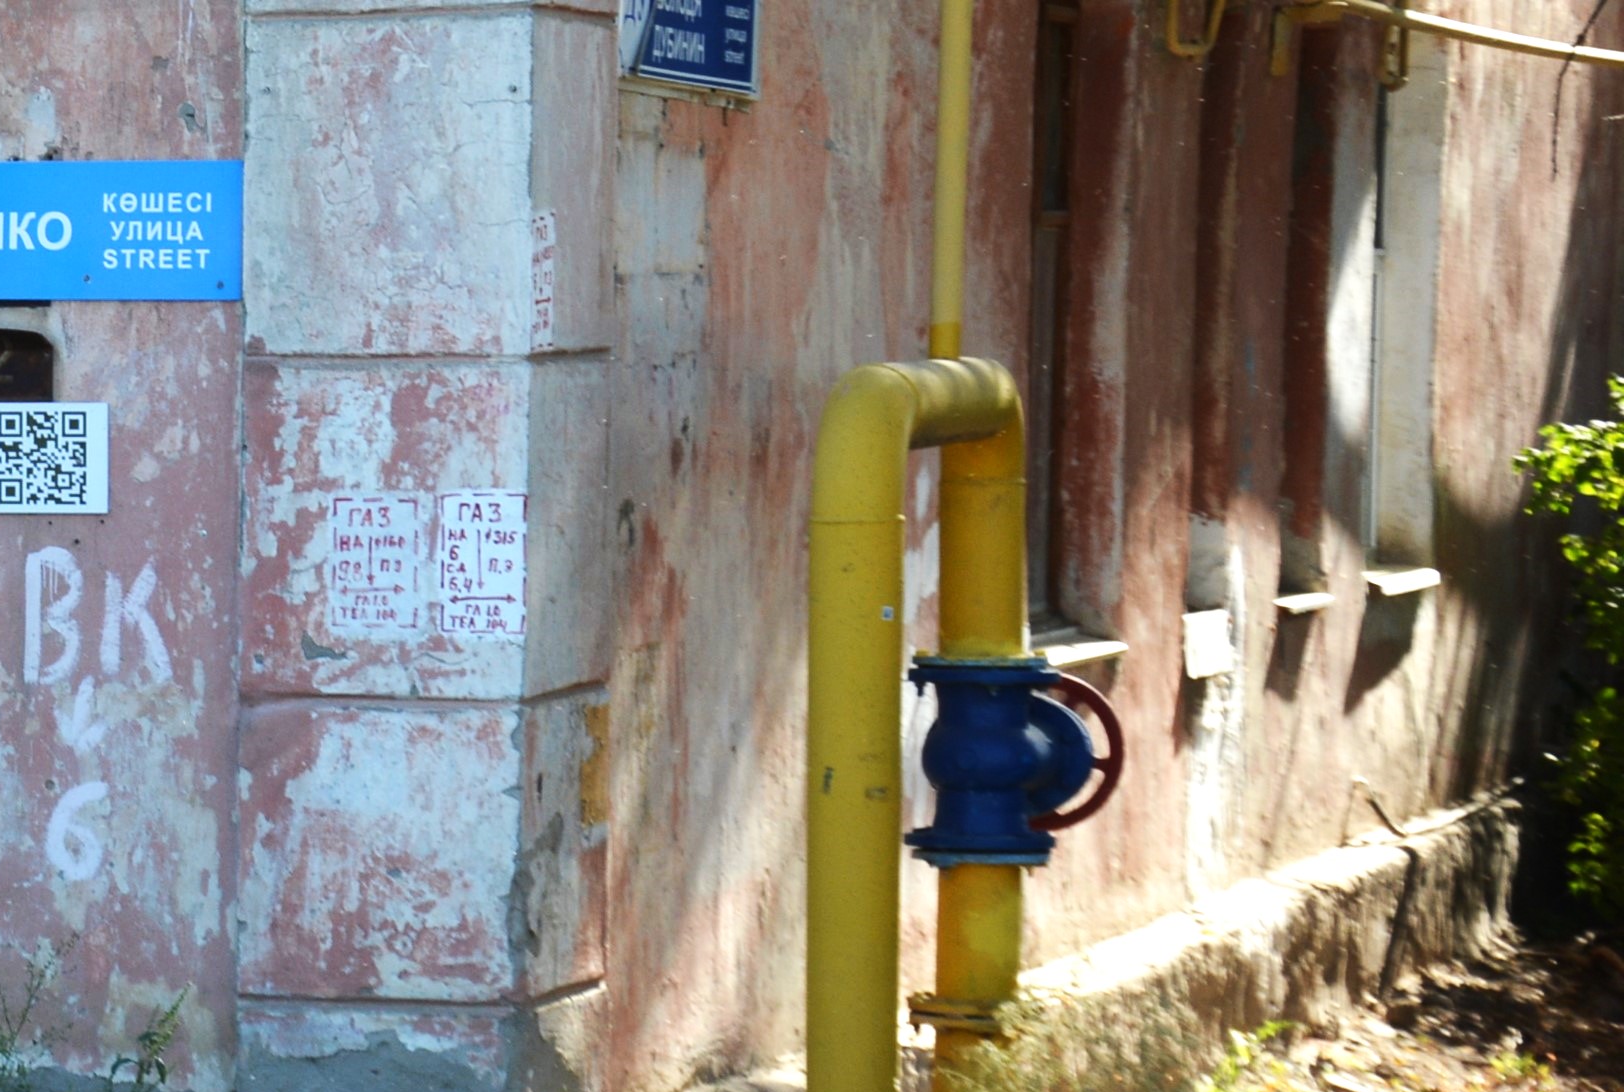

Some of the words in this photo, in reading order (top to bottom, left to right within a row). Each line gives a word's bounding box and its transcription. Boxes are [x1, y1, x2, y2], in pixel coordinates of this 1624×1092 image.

[102, 192, 213, 214] КӨШЕСІ
[110, 219, 205, 245] УЛИЦА
[102, 248, 212, 270] STREET
[348, 506, 391, 528] ГАЗ
[459, 503, 502, 523] ГАЗ
[339, 535, 364, 552] НА
[448, 528, 467, 541] НА
[44, 779, 109, 882] 6
